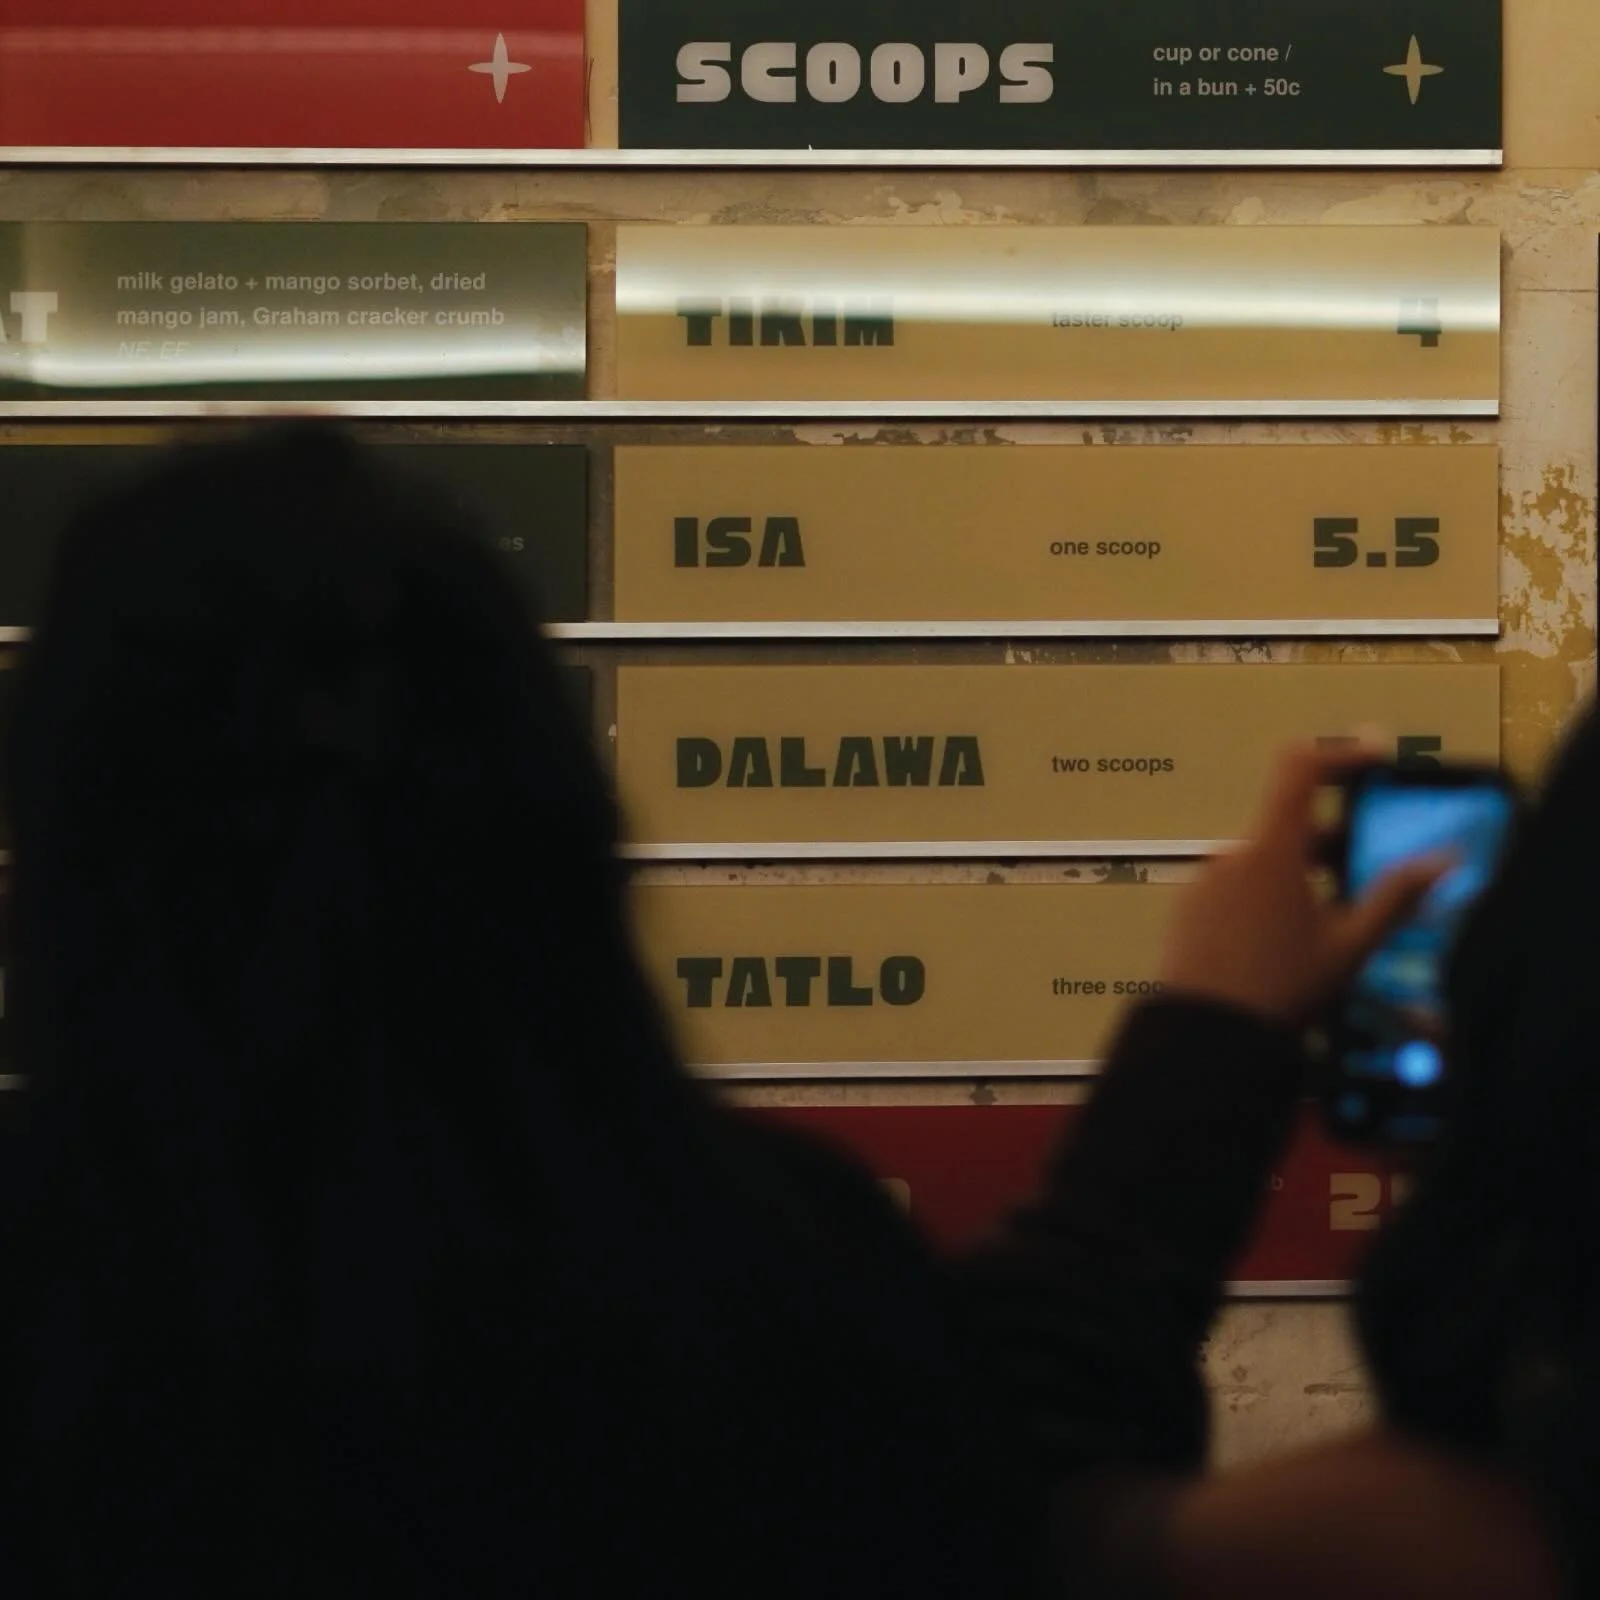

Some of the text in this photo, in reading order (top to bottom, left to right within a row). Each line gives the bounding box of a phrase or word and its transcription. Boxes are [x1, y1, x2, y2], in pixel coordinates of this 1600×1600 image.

[1153, 47, 1192, 65] cup
[1199, 47, 1221, 61] or
[1227, 47, 1279, 61] cone
[676, 41, 1054, 104] SCOOPS
[1153, 78, 1173, 95] in
[1179, 81, 1191, 95] a
[1198, 78, 1238, 95] bun
[1263, 79, 1301, 95] 50c
[117, 272, 163, 289] milk
[170, 272, 238, 294] gelato
[265, 275, 341, 294] mango
[347, 272, 424, 293] sorbet,
[430, 272, 486, 290] dried
[117, 307, 505, 328] mango jam, Graham cracker crumb
[676, 296, 895, 346] TIKIM
[1052, 311, 1183, 332] taster scoop
[1397, 297, 1441, 347] 4
[674, 517, 805, 567] ISA
[1050, 540, 1161, 559] one scoop
[1313, 517, 1440, 568] 5.5
[676, 736, 985, 787] DALAWA
[1052, 756, 1174, 775] two scoops
[677, 956, 926, 1007] TATLO
[1052, 978, 1164, 995] three scoo
